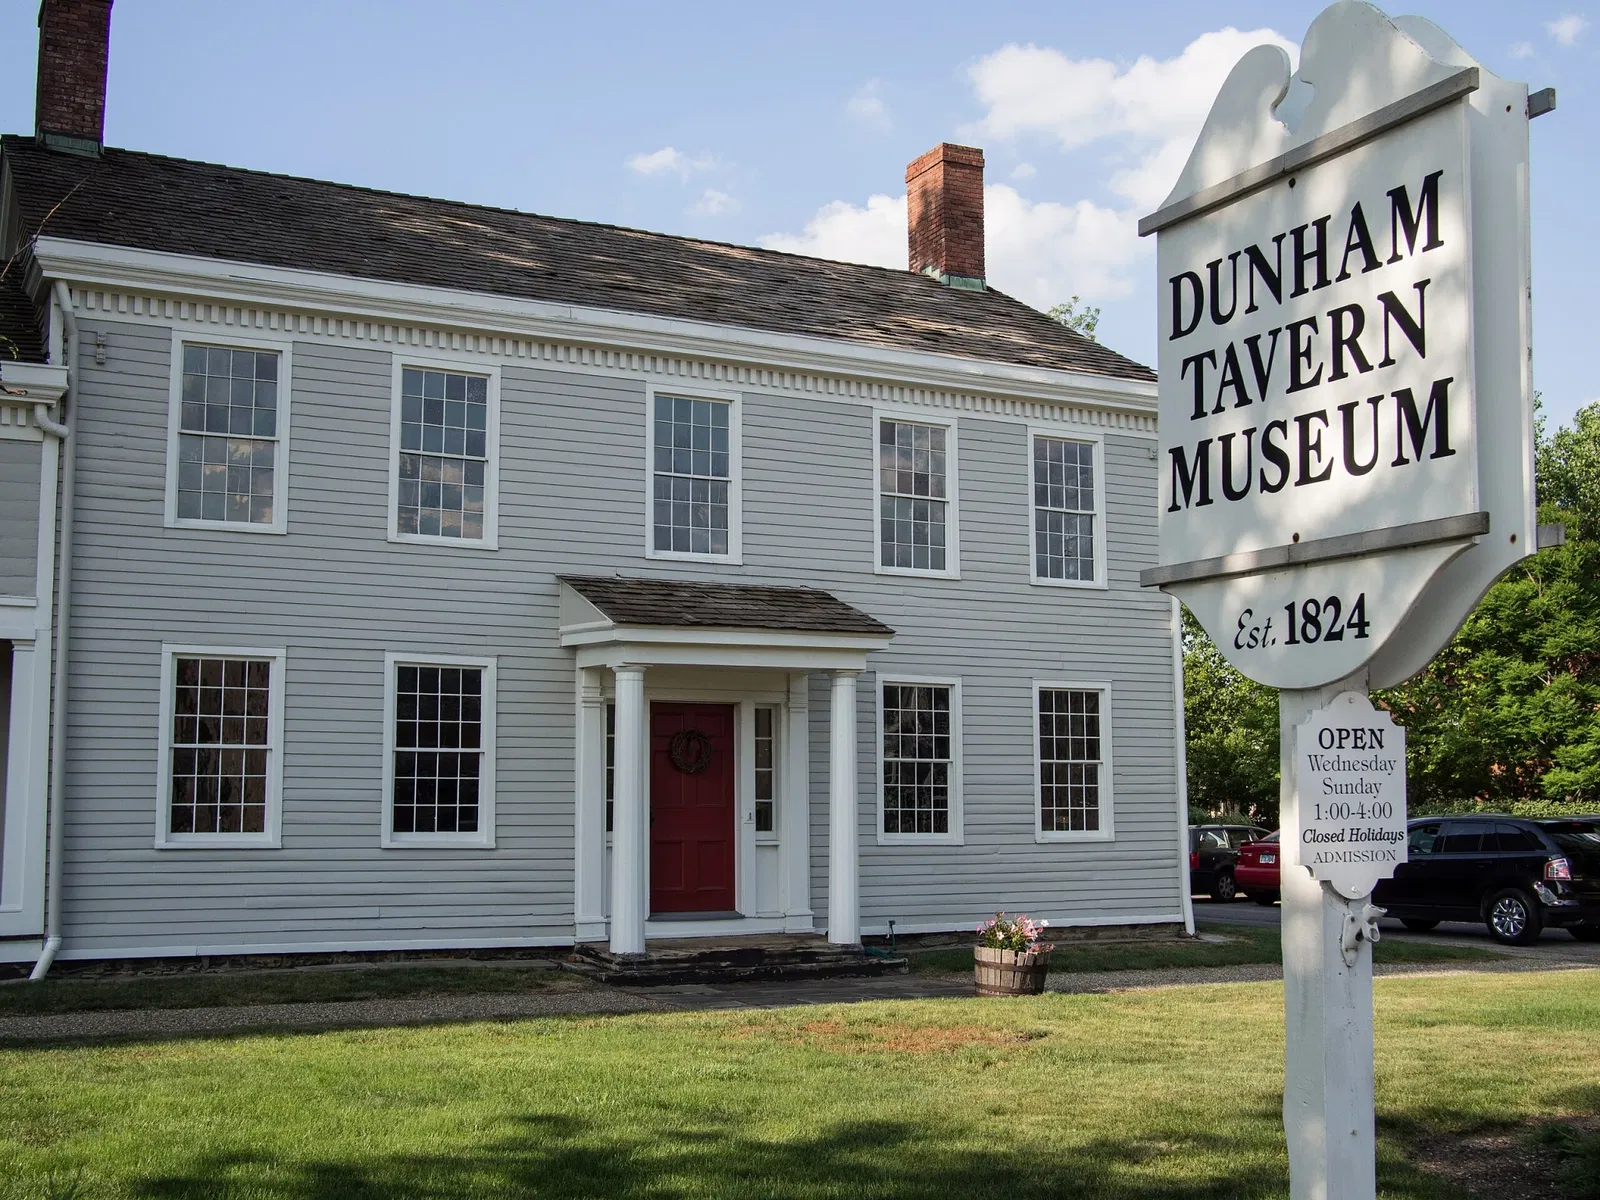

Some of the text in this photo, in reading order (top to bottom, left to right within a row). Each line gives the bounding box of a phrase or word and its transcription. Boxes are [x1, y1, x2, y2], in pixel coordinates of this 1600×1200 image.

[1169, 170, 1444, 341] DUNHAM
[1181, 278, 1431, 421] TAVERN
[1168, 377, 1456, 513] MUSEUM
[1234, 593, 1370, 650] Est. 1824
[1318, 727, 1385, 750] OPEN
[1307, 754, 1397, 775] Wednesday
[1322, 777, 1383, 798] Sunday
[1314, 801, 1393, 820] 1:00-4:00
[1302, 827, 1405, 844] Closed Holidays
[1313, 850, 1397, 863] ADMISSION
